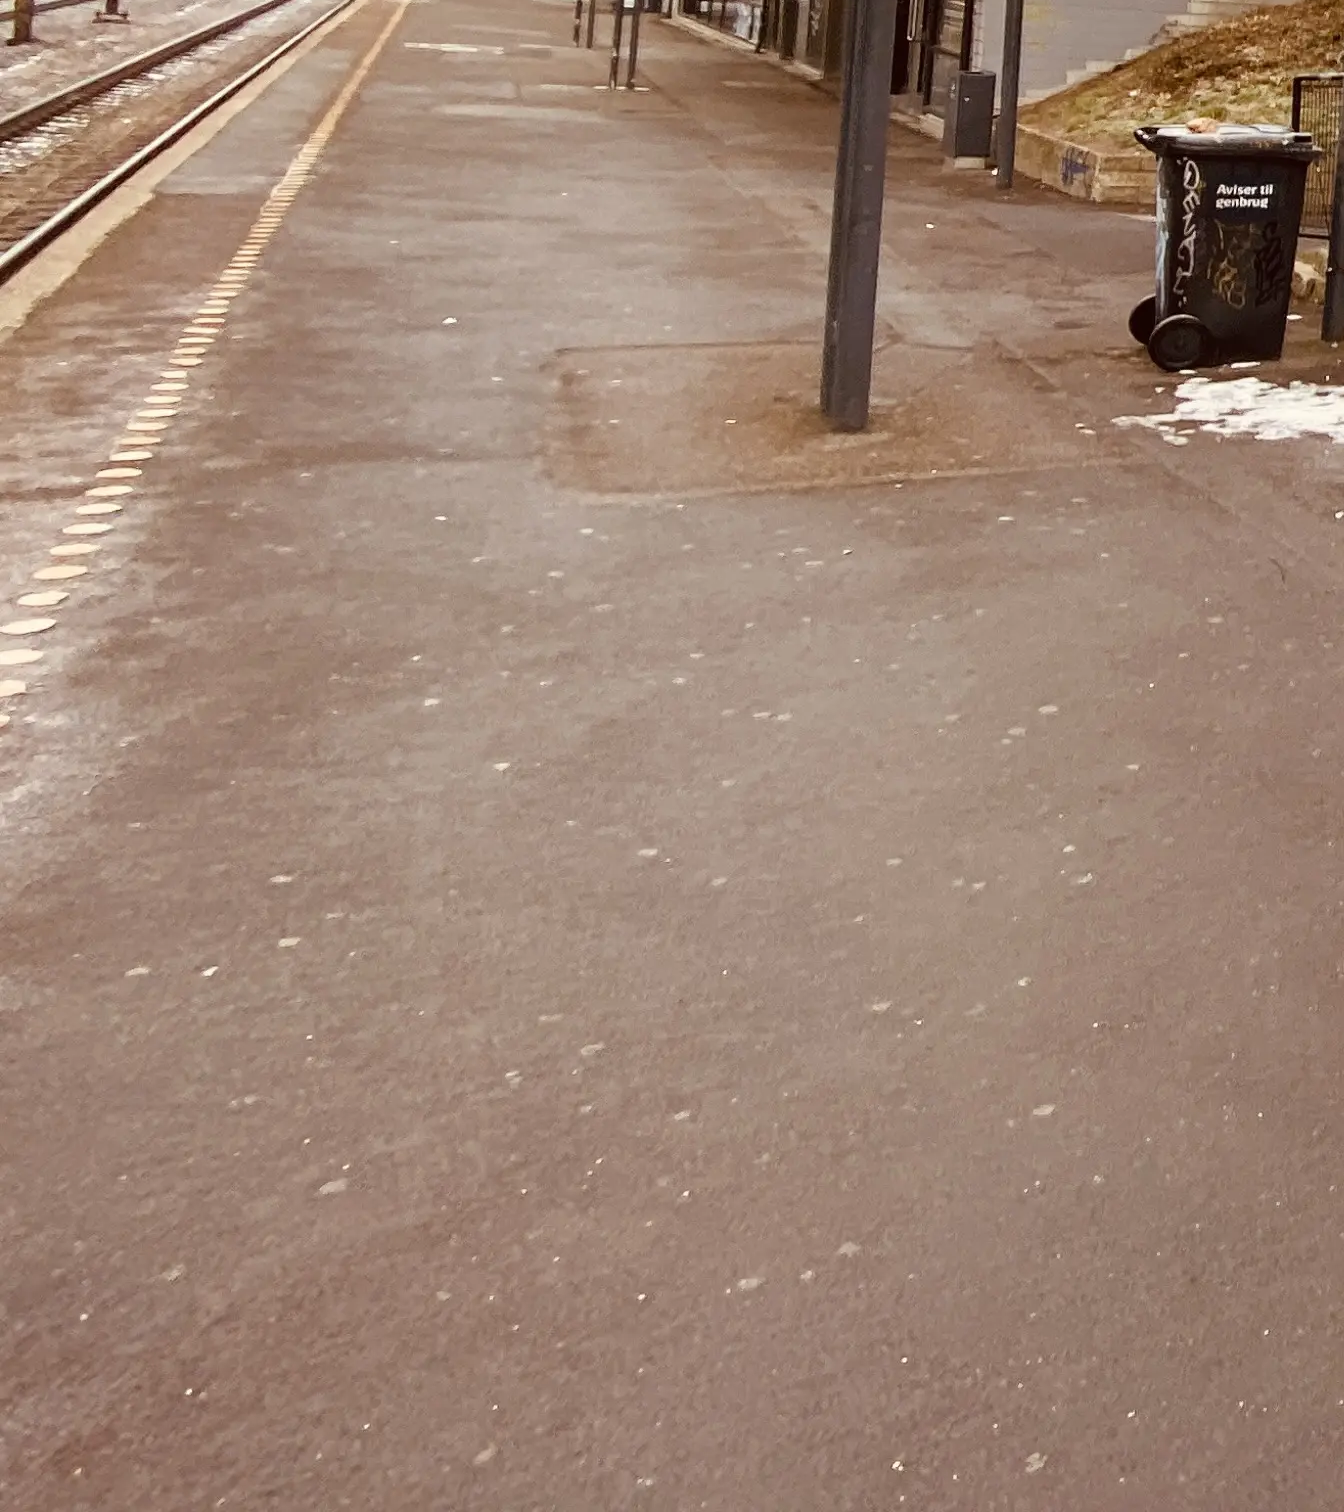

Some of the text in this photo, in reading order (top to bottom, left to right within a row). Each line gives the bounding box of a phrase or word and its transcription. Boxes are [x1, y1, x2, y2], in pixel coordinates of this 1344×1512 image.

[1216, 184, 1274, 196] Aviser til
[1215, 196, 1269, 209] genbrug
